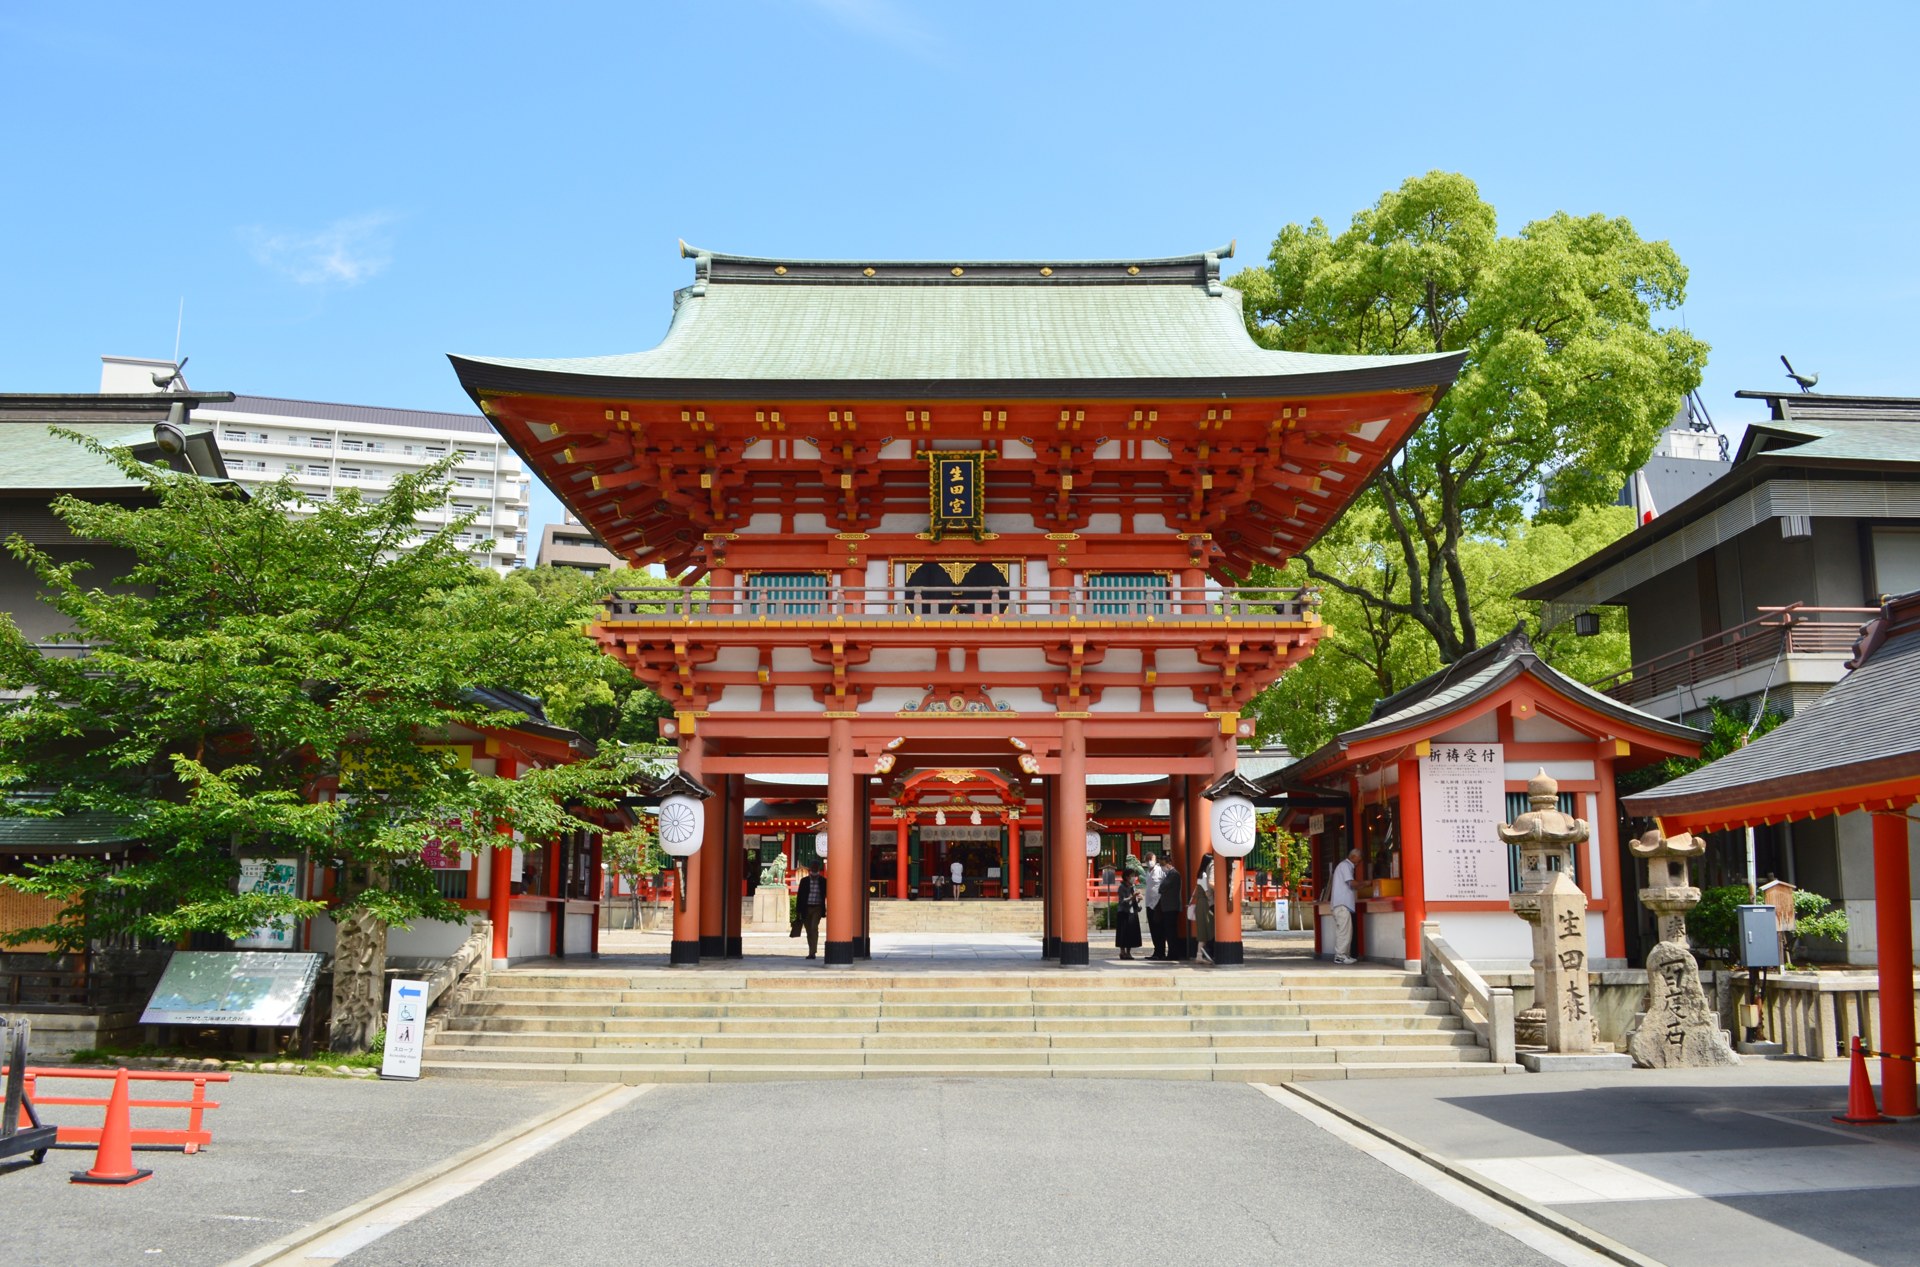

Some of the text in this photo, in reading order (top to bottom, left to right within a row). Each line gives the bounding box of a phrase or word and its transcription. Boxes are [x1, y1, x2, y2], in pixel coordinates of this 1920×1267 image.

[949, 465, 966, 514] 生田宮
[1558, 909, 1588, 1022] 生田森
[1659, 957, 1687, 1051] 百度石
